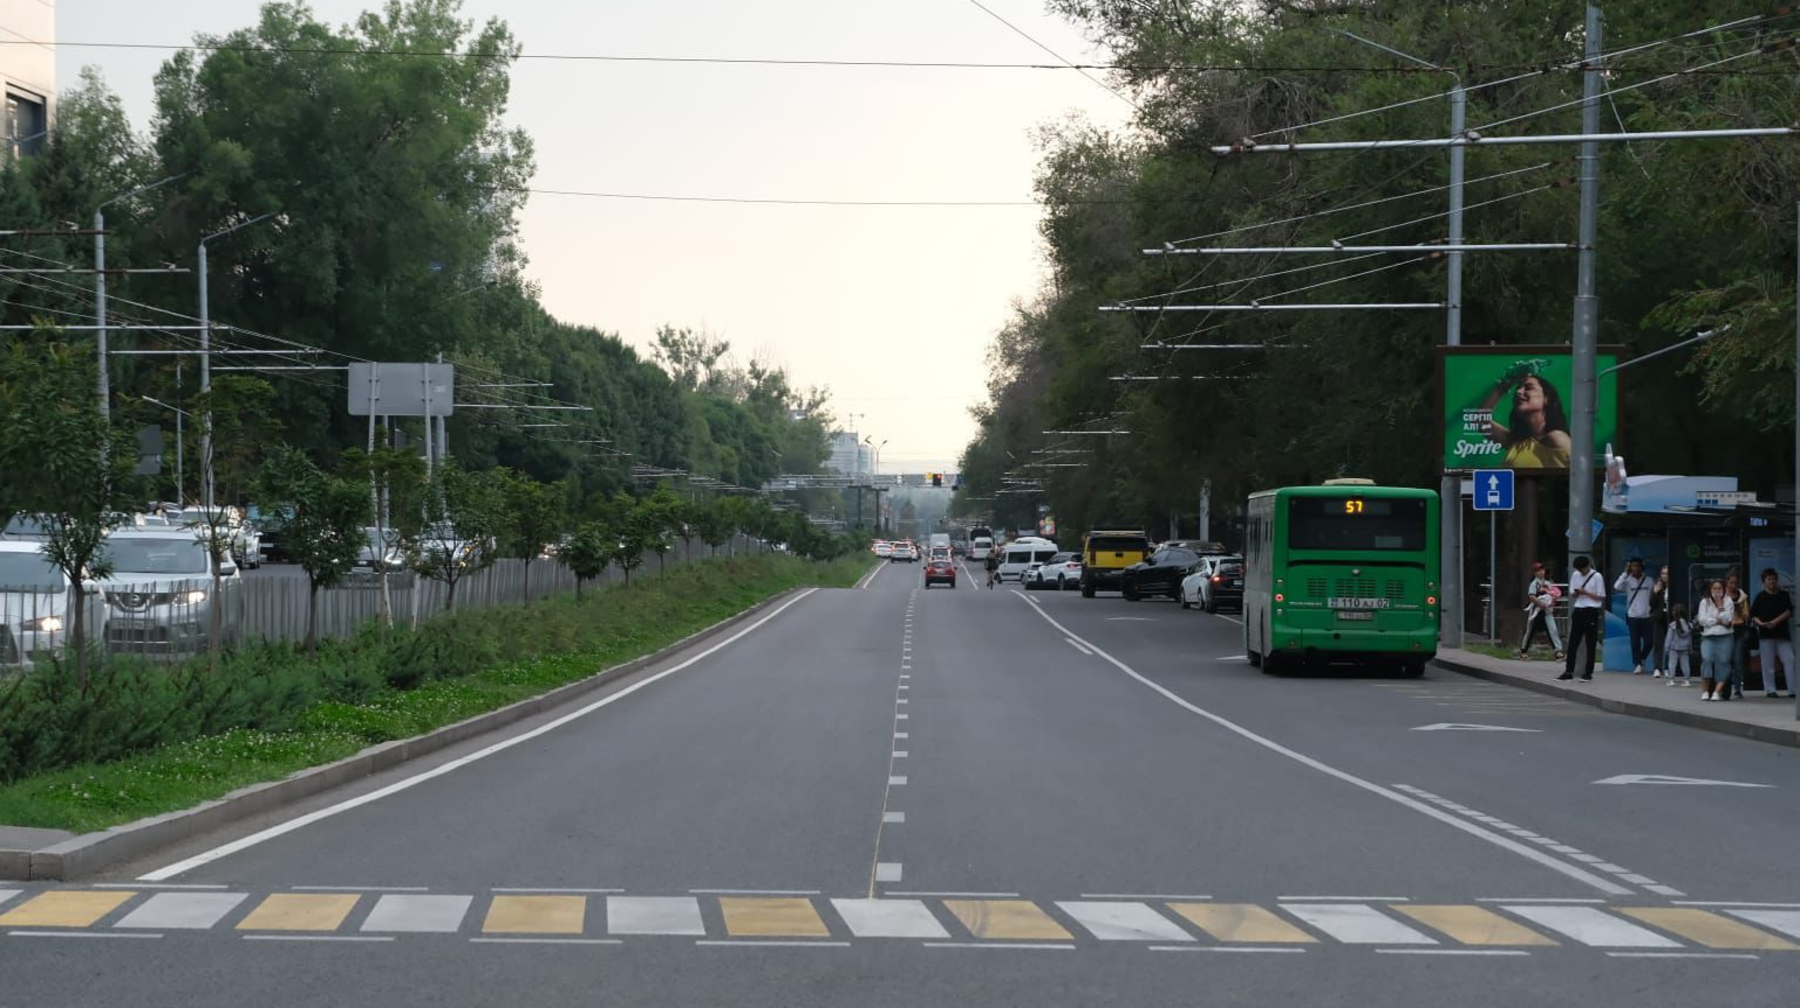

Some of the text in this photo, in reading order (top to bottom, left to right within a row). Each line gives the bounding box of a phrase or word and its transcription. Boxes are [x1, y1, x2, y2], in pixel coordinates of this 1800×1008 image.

[1453, 439, 1502, 458] Sprite
[1346, 501, 1363, 513] 57
[1342, 598, 1360, 608] 110
[1377, 599, 1388, 608] 02
